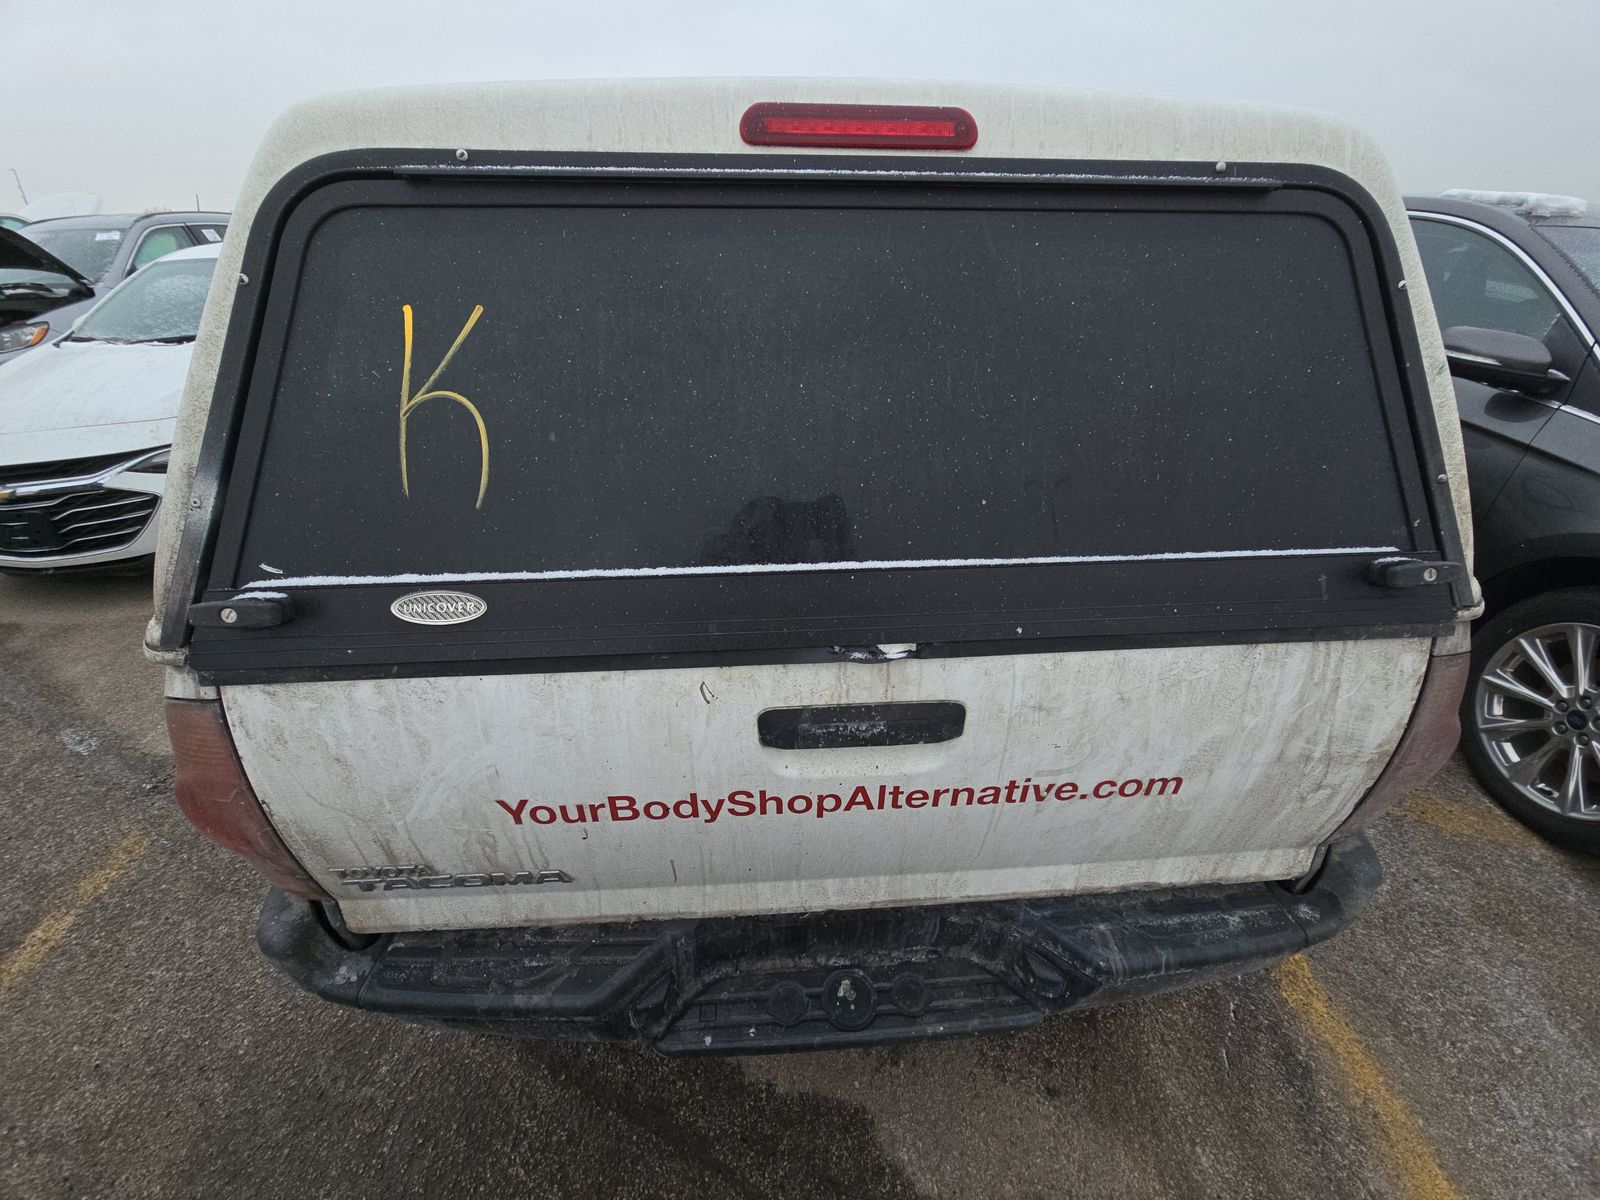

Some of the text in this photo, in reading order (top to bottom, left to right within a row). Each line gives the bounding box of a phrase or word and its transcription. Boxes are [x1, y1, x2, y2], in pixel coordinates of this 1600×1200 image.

[400, 304, 489, 509] K
[402, 601, 476, 615] UNICOVER
[495, 776, 1184, 825] YourBodyShopAlternative.com
[341, 869, 575, 892] TACOMA
